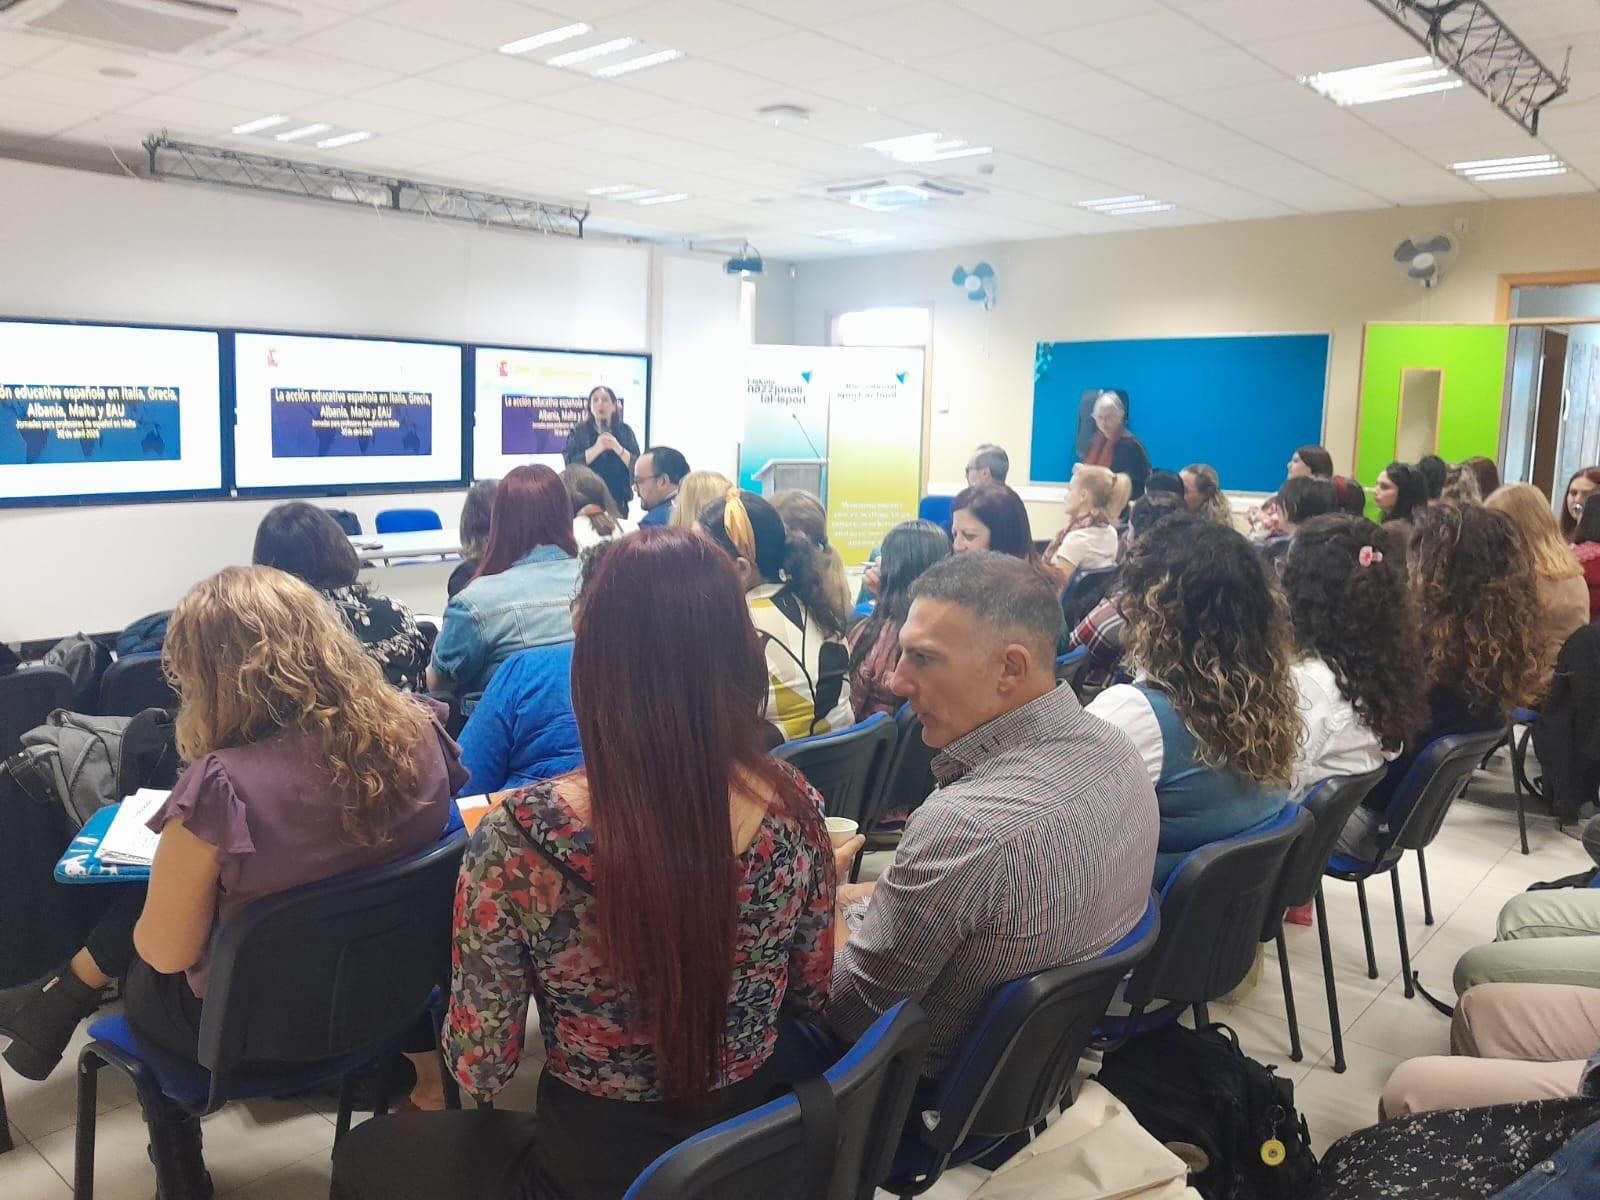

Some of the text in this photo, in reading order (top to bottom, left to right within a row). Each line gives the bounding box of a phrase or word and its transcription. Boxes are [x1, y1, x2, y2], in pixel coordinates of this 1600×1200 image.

[14, 384, 61, 400] educativa
[63, 385, 105, 402] española
[108, 388, 120, 400] en
[122, 386, 146, 402] Italia,
[147, 387, 178, 402] Grecia,
[275, 389, 285, 402] La
[286, 389, 310, 403] acción
[311, 389, 345, 404] educativa
[347, 391, 378, 406] española
[380, 393, 388, 403] en
[27, 402, 67, 418] Albania,
[69, 402, 95, 417] Malta
[97, 405, 104, 418] y
[320, 405, 349, 418] Albania,
[350, 406, 370, 418] Malta
[371, 409, 377, 420] y
